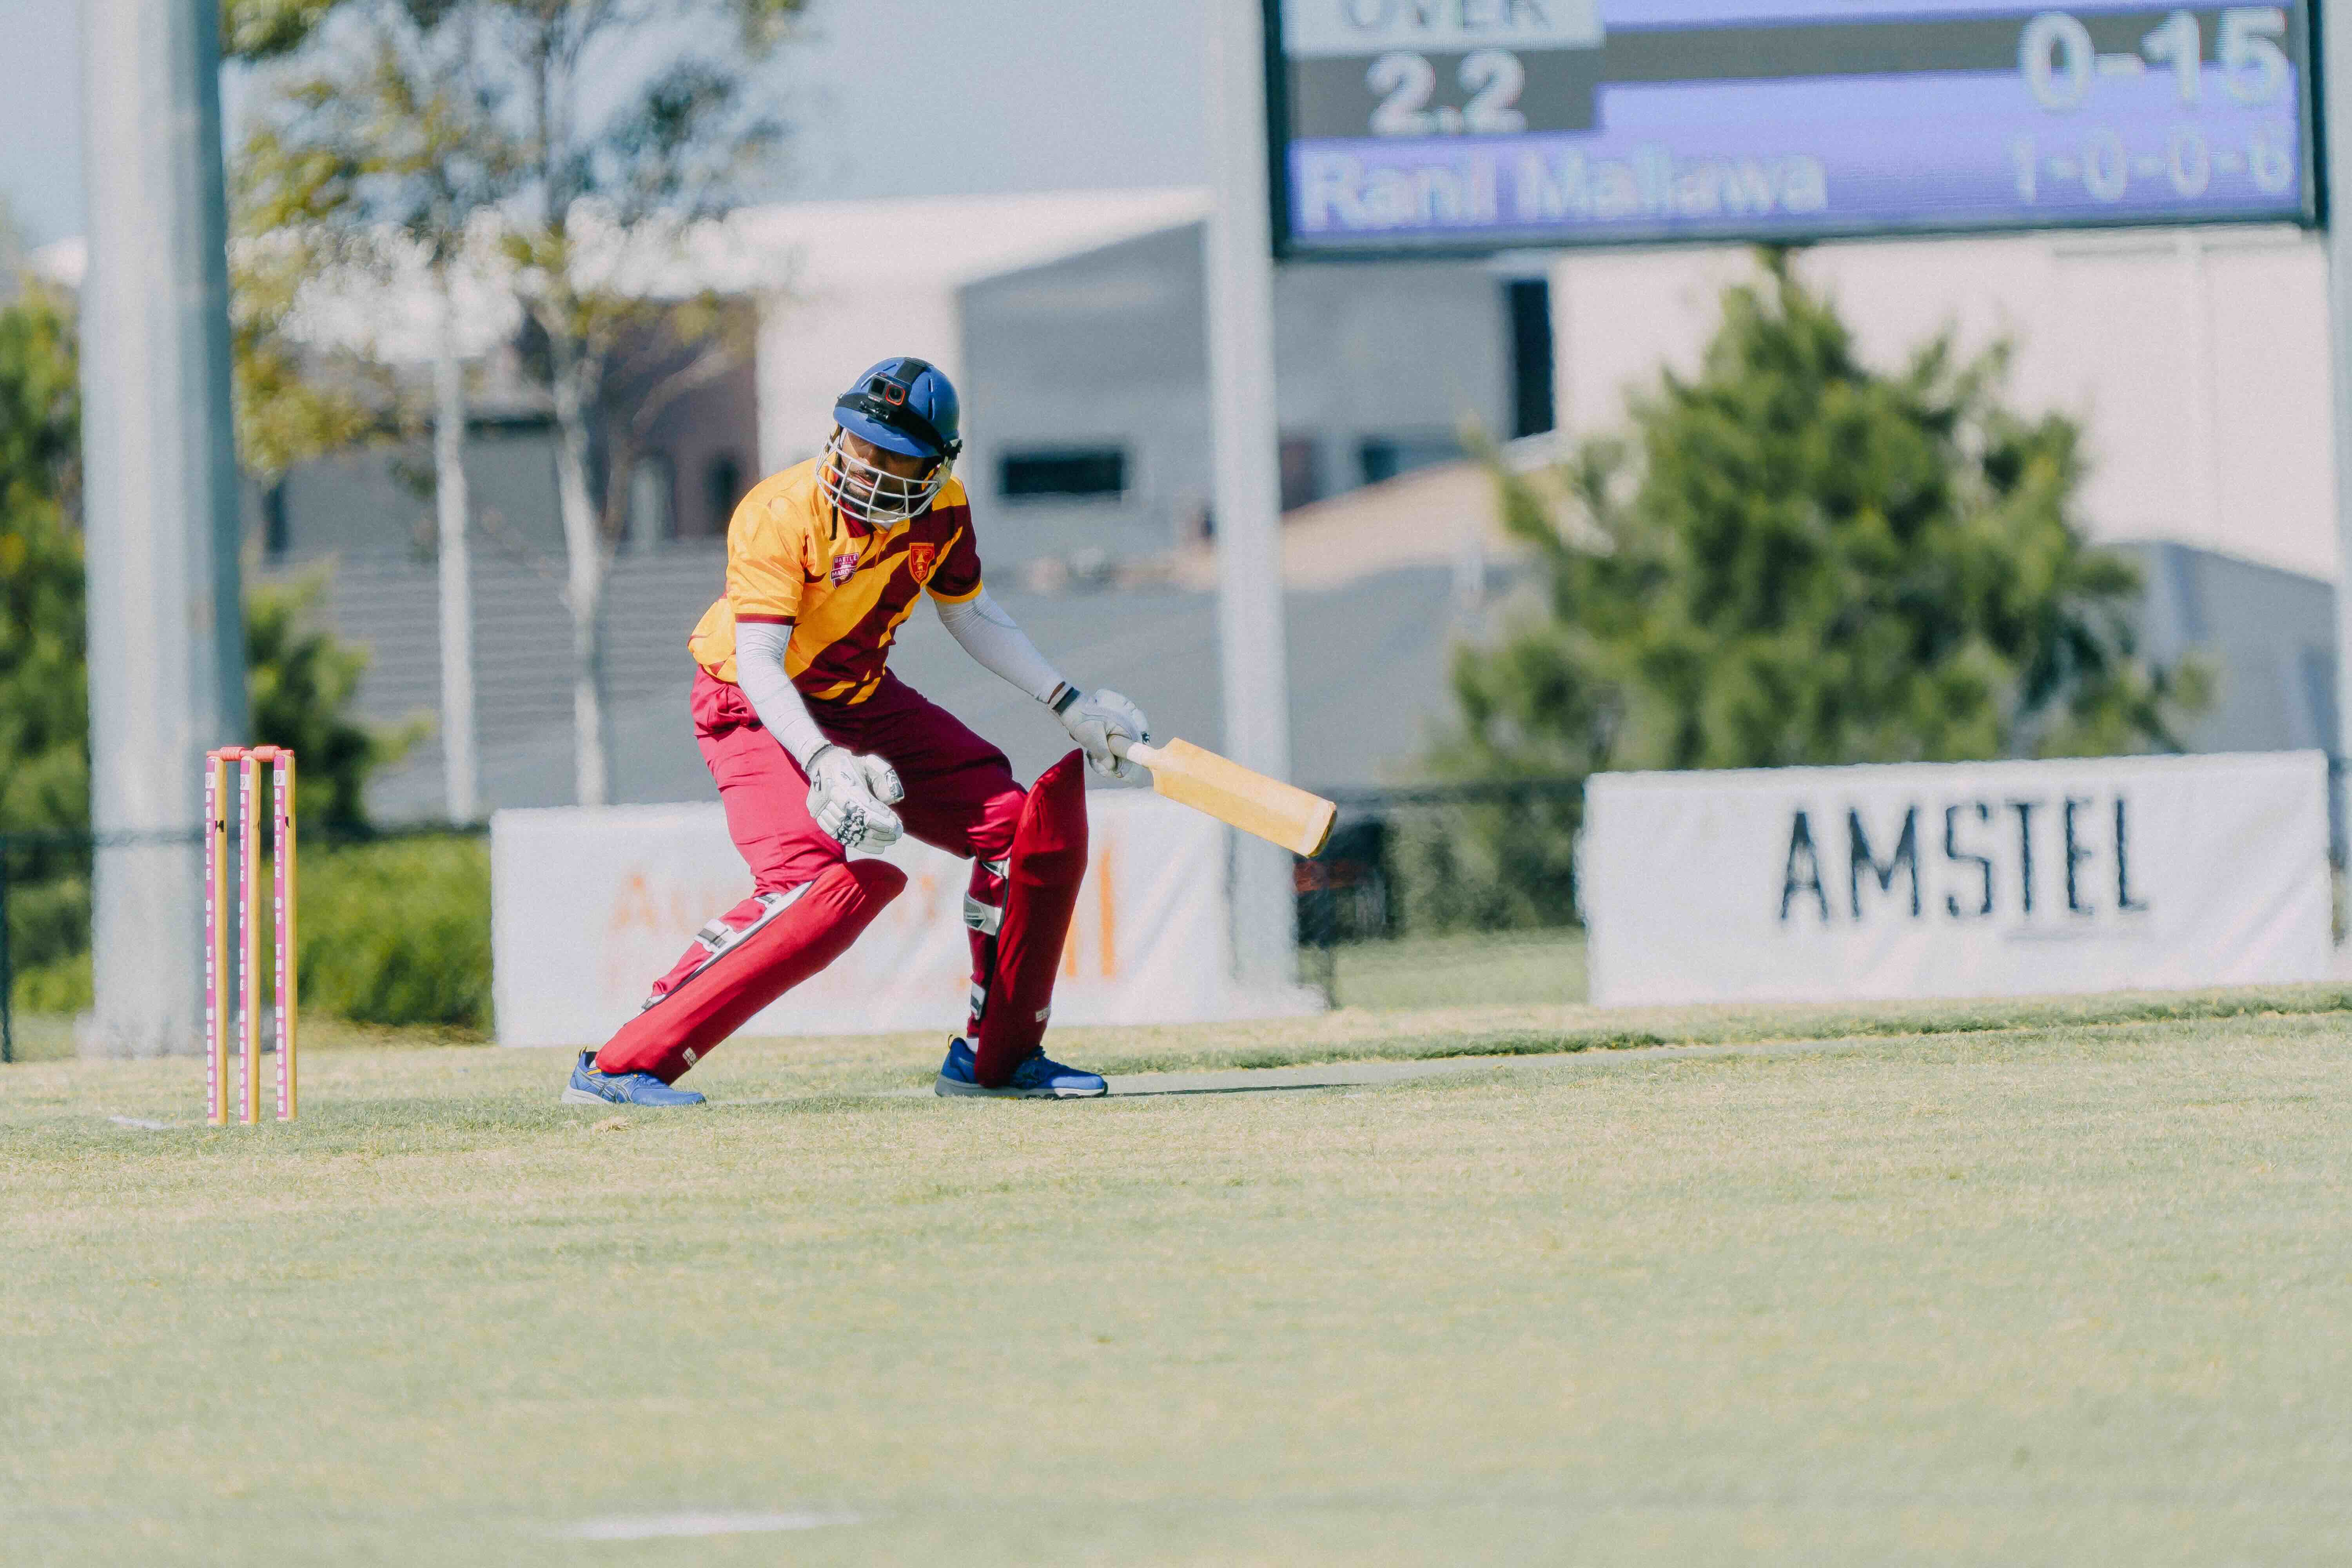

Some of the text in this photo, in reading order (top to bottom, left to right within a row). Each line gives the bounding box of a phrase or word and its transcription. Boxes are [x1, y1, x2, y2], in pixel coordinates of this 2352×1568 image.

[1365, 50, 1528, 134] 2.2
[2018, 7, 2288, 114] 0-15
[1778, 797, 2149, 922] AMSTEL
